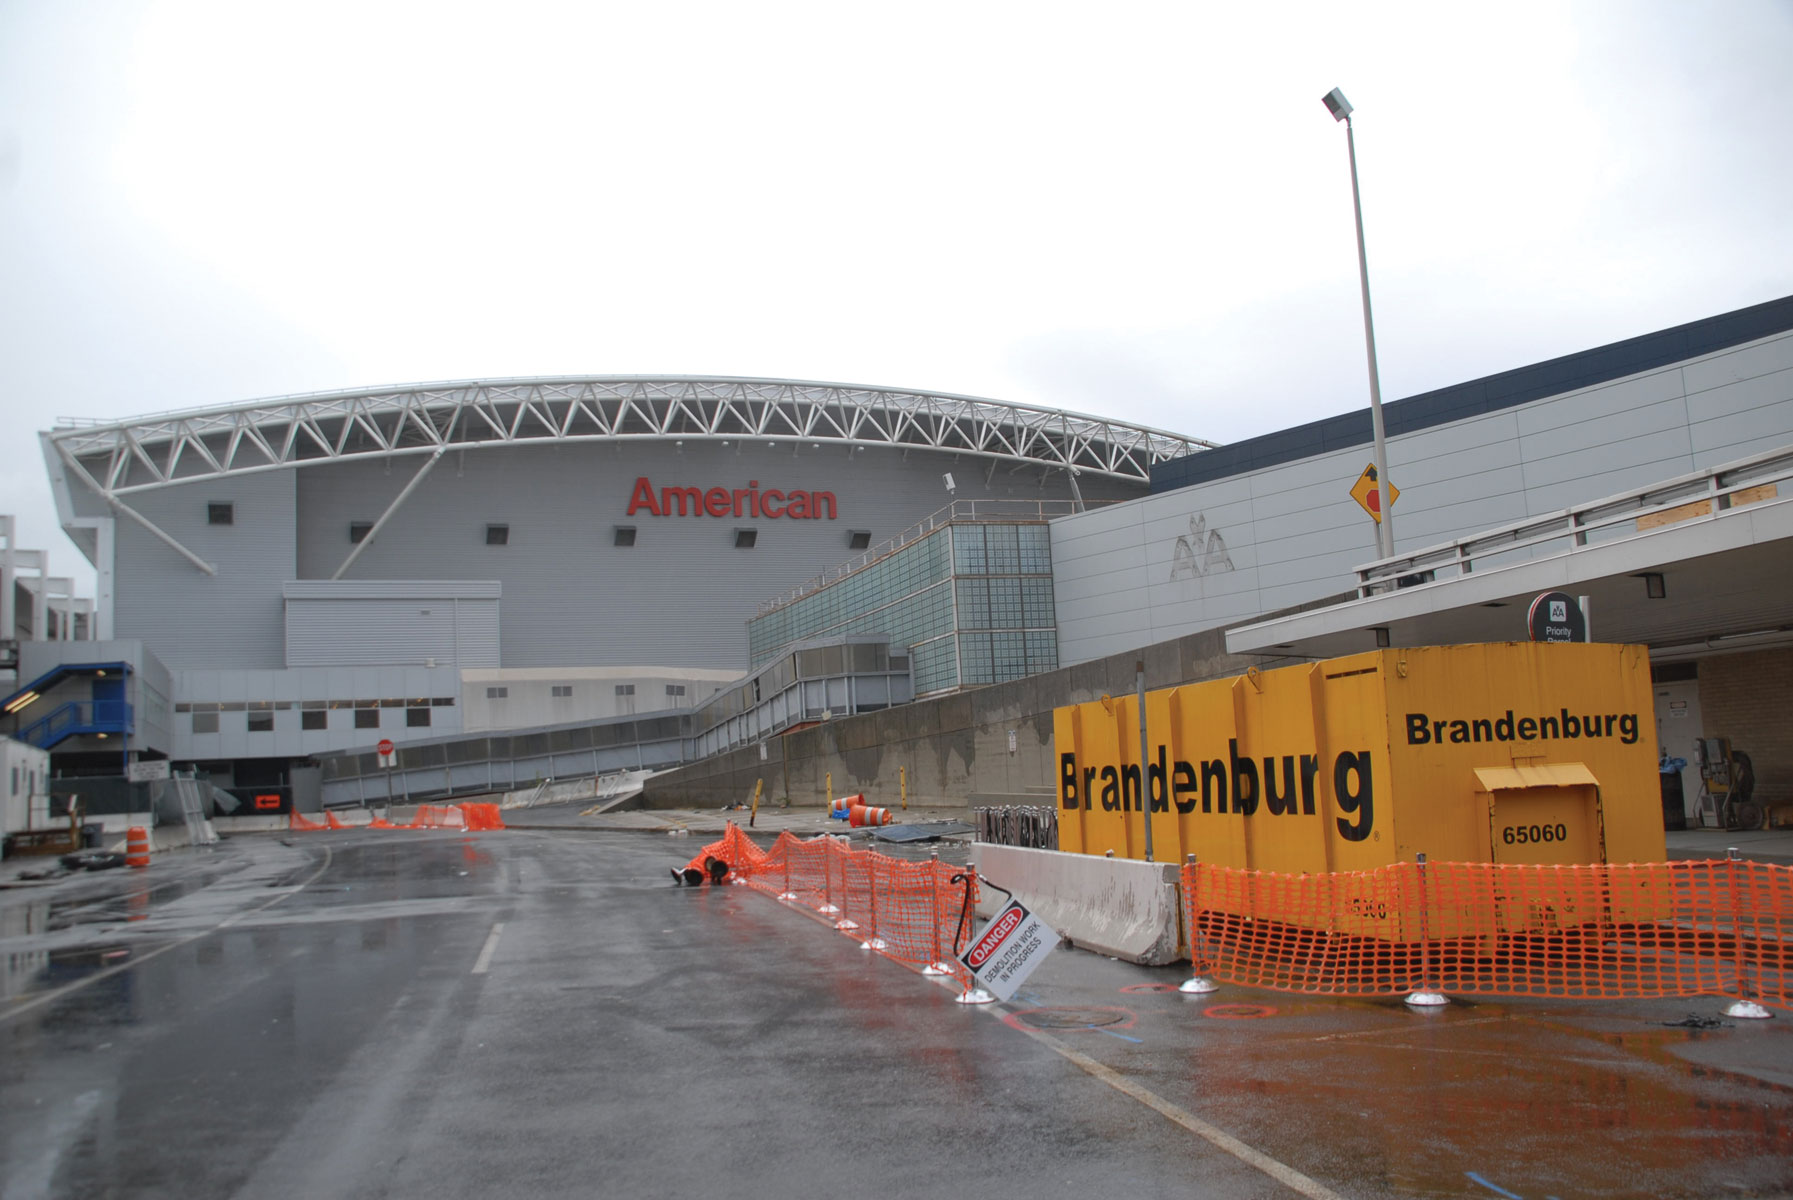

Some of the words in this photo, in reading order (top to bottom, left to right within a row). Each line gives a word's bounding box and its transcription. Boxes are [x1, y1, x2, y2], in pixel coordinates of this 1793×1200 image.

[627, 477, 837, 519] American
[1546, 626, 1571, 637] Priority
[1406, 708, 1639, 745] Brandenburg
[1061, 738, 1374, 842] Brandenburg
[1503, 824, 1567, 844] 65060
[974, 913, 1018, 961] DANGER
[984, 941, 1022, 983] DEMOLITION
[1019, 921, 1041, 945] WORK
[1000, 973, 1010, 982] IN
[1008, 936, 1042, 976] PROGRESS
